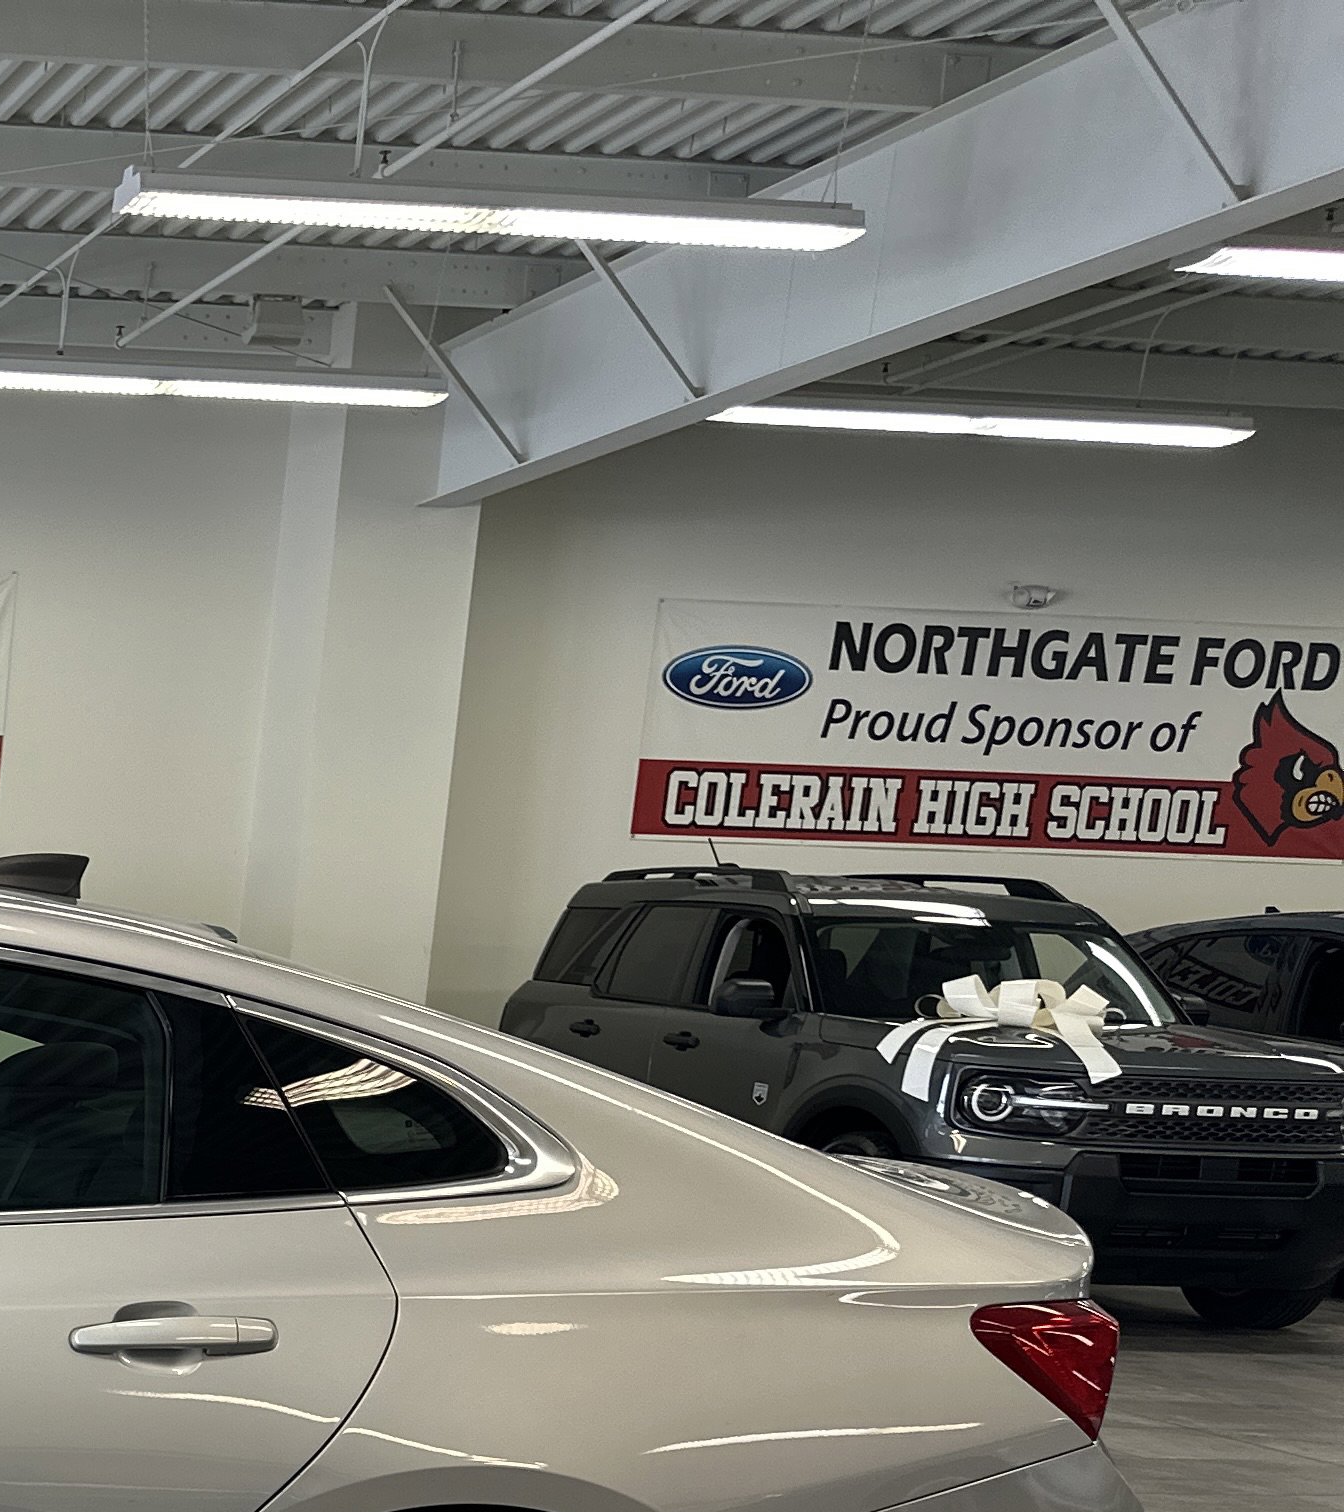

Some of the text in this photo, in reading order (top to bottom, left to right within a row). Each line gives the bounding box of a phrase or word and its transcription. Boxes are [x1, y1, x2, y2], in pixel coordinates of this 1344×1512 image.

[689, 655, 785, 699] Ford
[829, 621, 1341, 691] NORTHGATE FORD
[820, 698, 1203, 756] Proud Sponsor of
[663, 767, 1229, 846] COLERAIN HIGH SCHOOL
[1125, 1103, 1320, 1120] BRONCO
